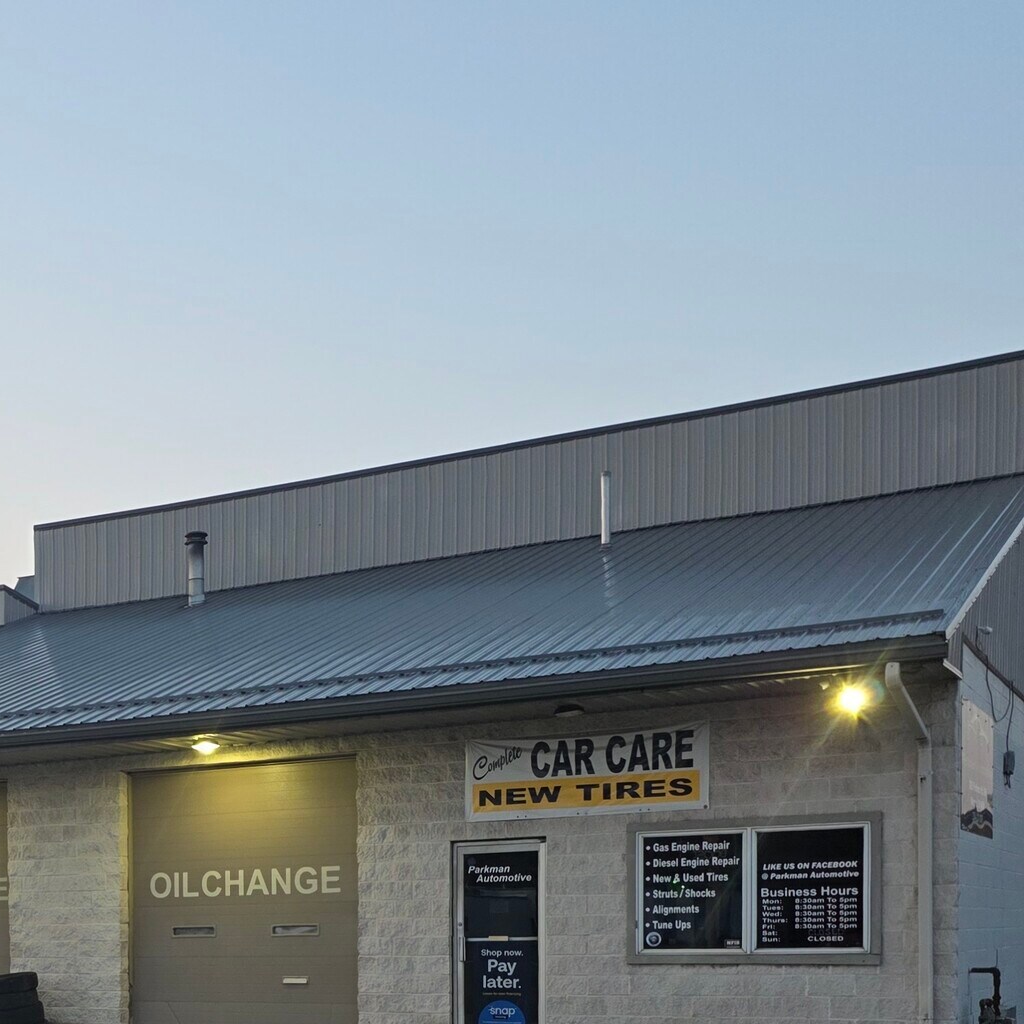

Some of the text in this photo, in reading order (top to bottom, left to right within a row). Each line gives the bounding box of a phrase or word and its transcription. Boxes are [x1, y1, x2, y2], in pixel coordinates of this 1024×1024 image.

[530, 729, 695, 779] CAR CARE
[472, 746, 523, 781] Complete
[478, 777, 694, 807] NEW TIRES
[652, 840, 730, 853] Gas Engine Repair
[652, 856, 740, 869] Diesel Engine Repair
[762, 863, 782, 871] LIKE
[783, 862, 795, 870] US
[811, 860, 858, 869] FACEBOOK
[467, 864, 511, 874] Parkman
[770, 872, 808, 880] Parkman
[809, 870, 860, 879] Automotive
[149, 865, 342, 899] OILCHANGE
[476, 872, 532, 883] Automotive
[652, 872, 729, 884] New & Used Tires
[760, 886, 859, 898] Business Hours
[652, 905, 700, 916] Alignments
[652, 919, 691, 931] Tune Ups
[480, 949, 502, 958] Shop
[487, 959, 517, 976] Pay
[482, 974, 522, 989] later.
[488, 1006, 516, 1018] snap
